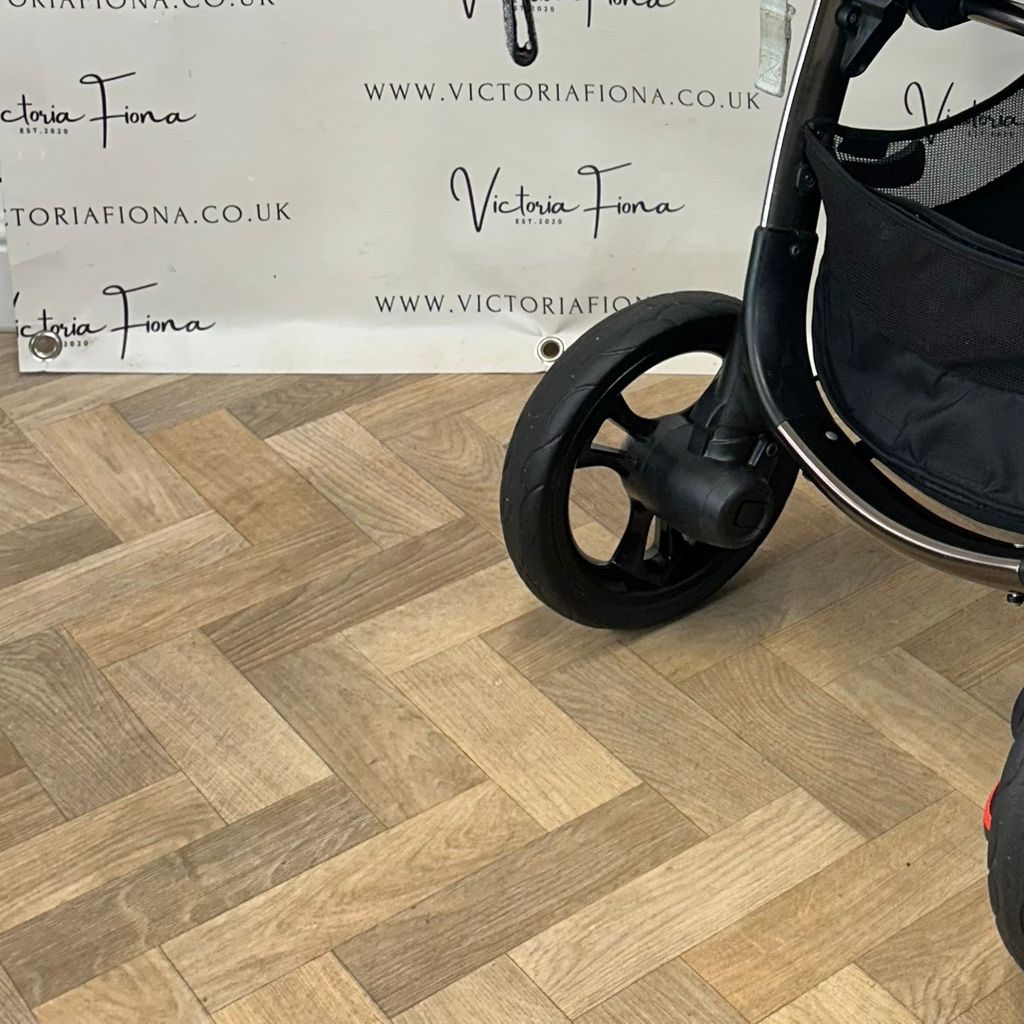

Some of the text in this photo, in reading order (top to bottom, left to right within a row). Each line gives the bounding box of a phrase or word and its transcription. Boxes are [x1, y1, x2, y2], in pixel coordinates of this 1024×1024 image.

[80, 72, 197, 148] Fiona
[364, 82, 760, 109] WWW.VICTORIAFIONA.CO.UK
[450, 162, 685, 239] Victoria Fiona
[102, 283, 216, 359] Fiona
